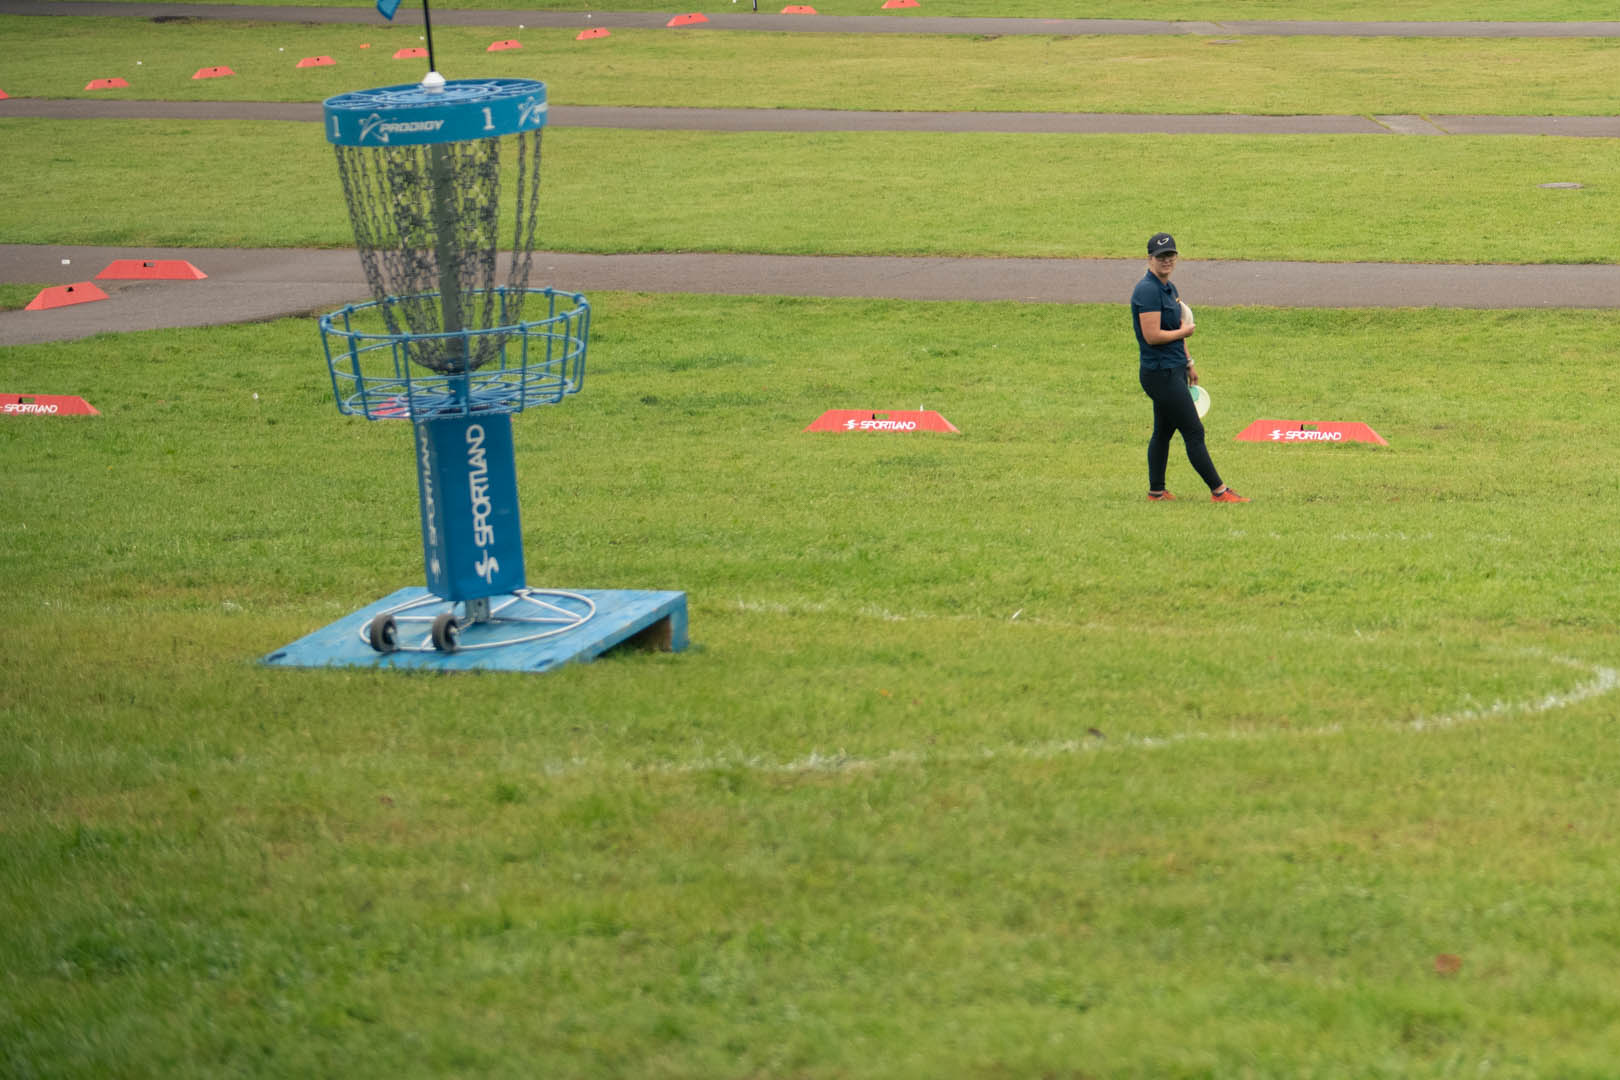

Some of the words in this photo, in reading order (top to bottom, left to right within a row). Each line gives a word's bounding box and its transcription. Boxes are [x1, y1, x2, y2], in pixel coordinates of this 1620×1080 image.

[331, 115, 342, 137] 1
[379, 119, 444, 133] PRODIGY
[482, 107, 495, 130] 1
[3, 403, 58, 414] SPORTLAND
[859, 420, 917, 430] SPORTLAND
[1284, 430, 1342, 441] SPORTLAND
[466, 423, 495, 547] SPORTLAND
